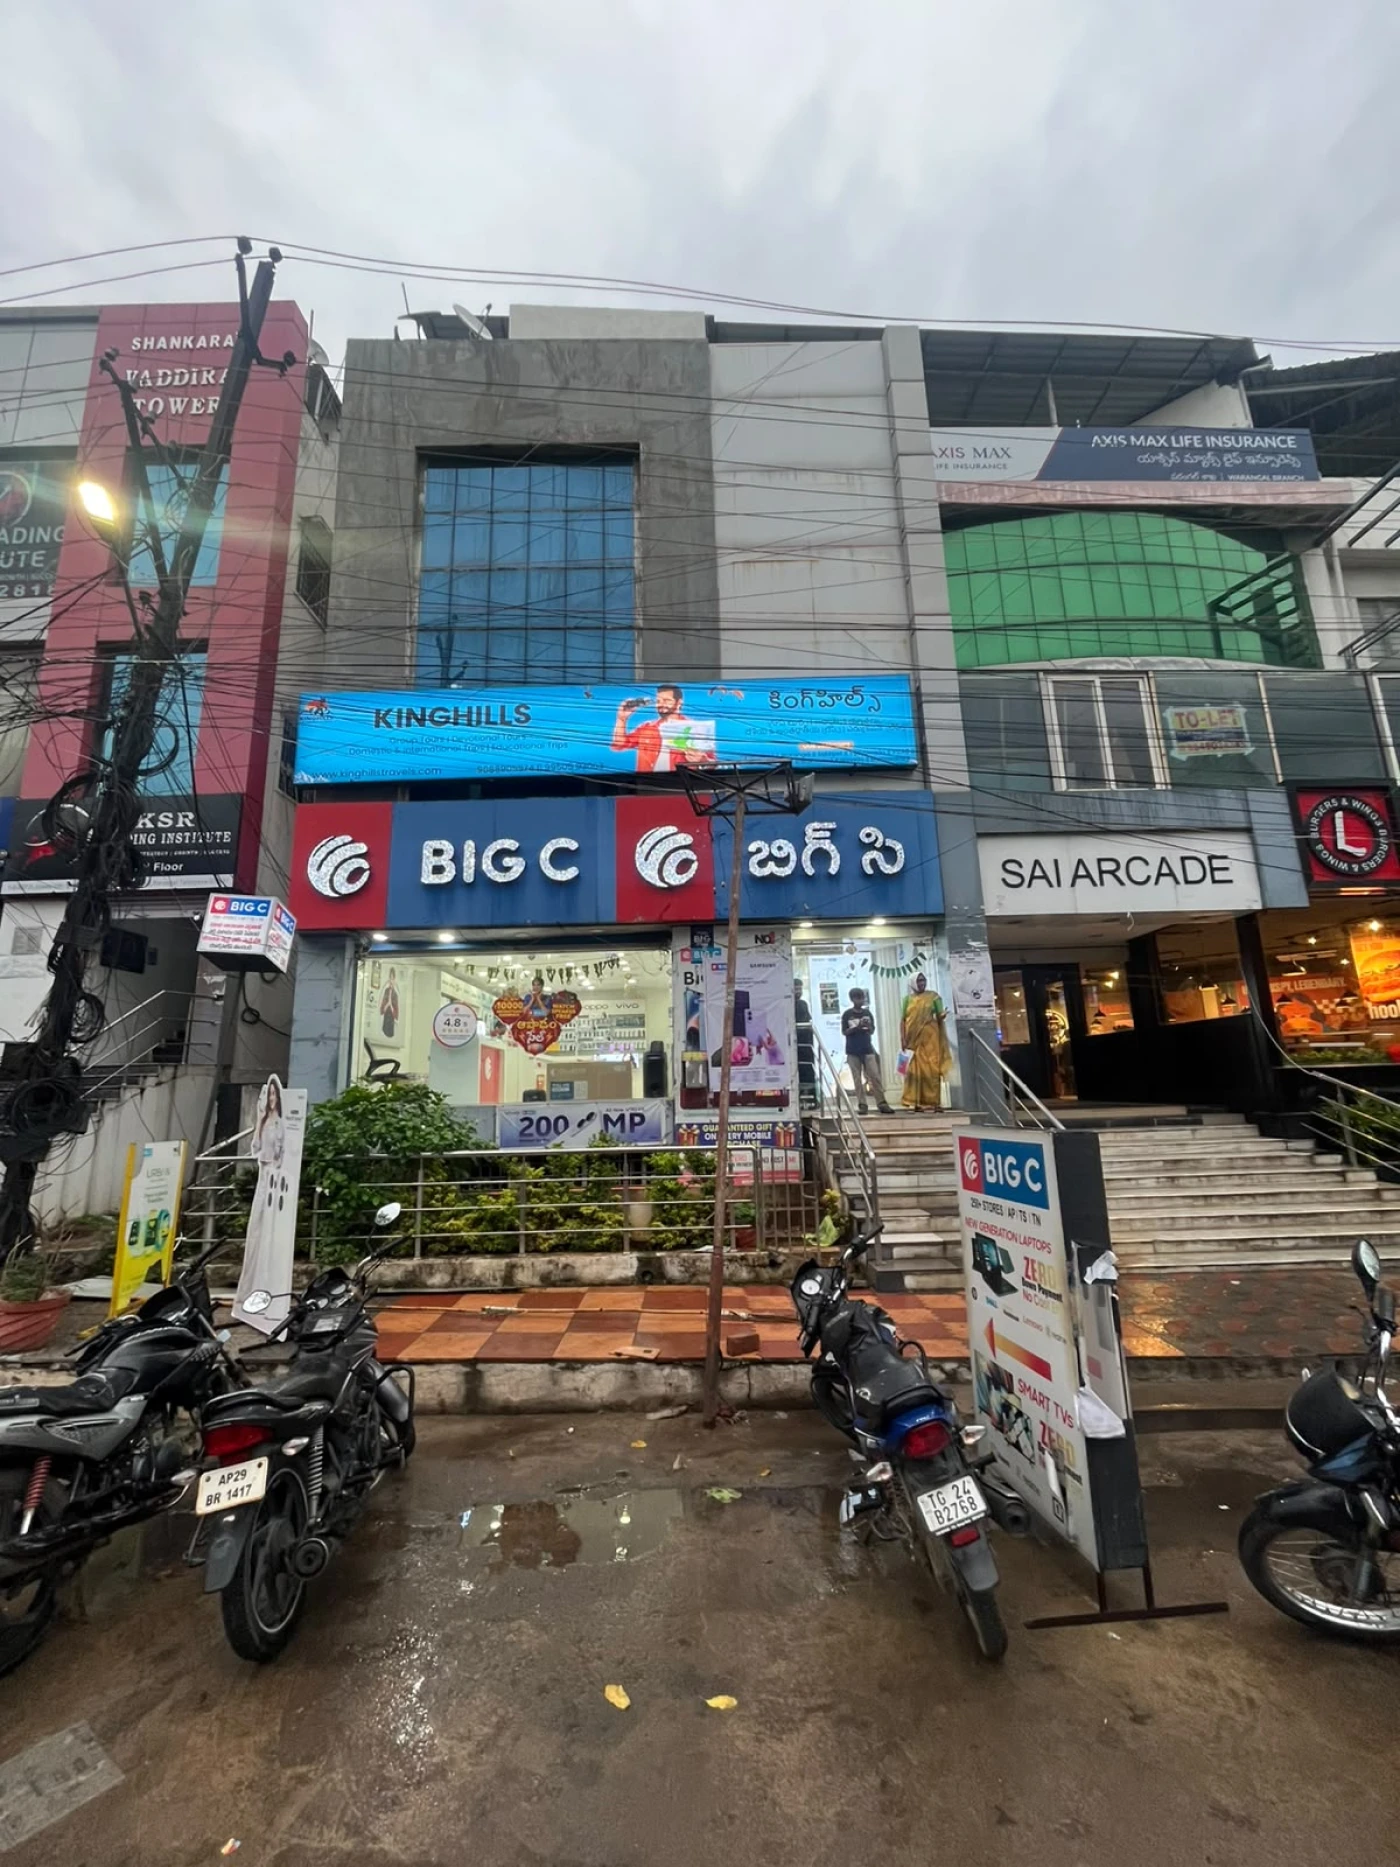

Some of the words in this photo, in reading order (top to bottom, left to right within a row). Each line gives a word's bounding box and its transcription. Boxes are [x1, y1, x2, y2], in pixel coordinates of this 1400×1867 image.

[972, 447, 1012, 458] MAX
[1091, 435, 1127, 448] AXIS
[1130, 435, 1169, 447] MAX
[1171, 435, 1203, 448] LIFE
[1205, 435, 1297, 448] INSURANCE
[374, 703, 532, 728] KINGHILLS
[134, 812, 195, 829] KSR
[130, 833, 156, 845] ING
[161, 831, 232, 844] INSTITUTE
[747, 821, 841, 879] బిగ్
[858, 825, 905, 876] సి
[153, 862, 184, 871] Floor
[420, 838, 526, 884] BIG
[539, 837, 580, 882] C
[1001, 857, 1061, 888] SAI
[1070, 855, 1234, 887] ARCADE
[230, 901, 255, 912] BIG
[257, 903, 267, 913] C
[519, 1115, 569, 1137] 200
[602, 1112, 646, 1134] MP
[743, 1131, 772, 1140] MOBILE
[983, 1152, 1021, 1188] BIG
[1024, 1158, 1042, 1192] C
[982, 1200, 1004, 1216] STORES
[1019, 1209, 1027, 1223] TS
[979, 1221, 1018, 1243] GENERATION
[1019, 1233, 1052, 1254] LAPTOPS
[1018, 1378, 1051, 1412] SMART
[218, 1468, 247, 1486] AP29
[205, 1492, 222, 1507] BR
[226, 1483, 252, 1500] 1417
[928, 1490, 946, 1509] TG
[951, 1480, 971, 1499] 24
[933, 1496, 977, 1525] B2768
